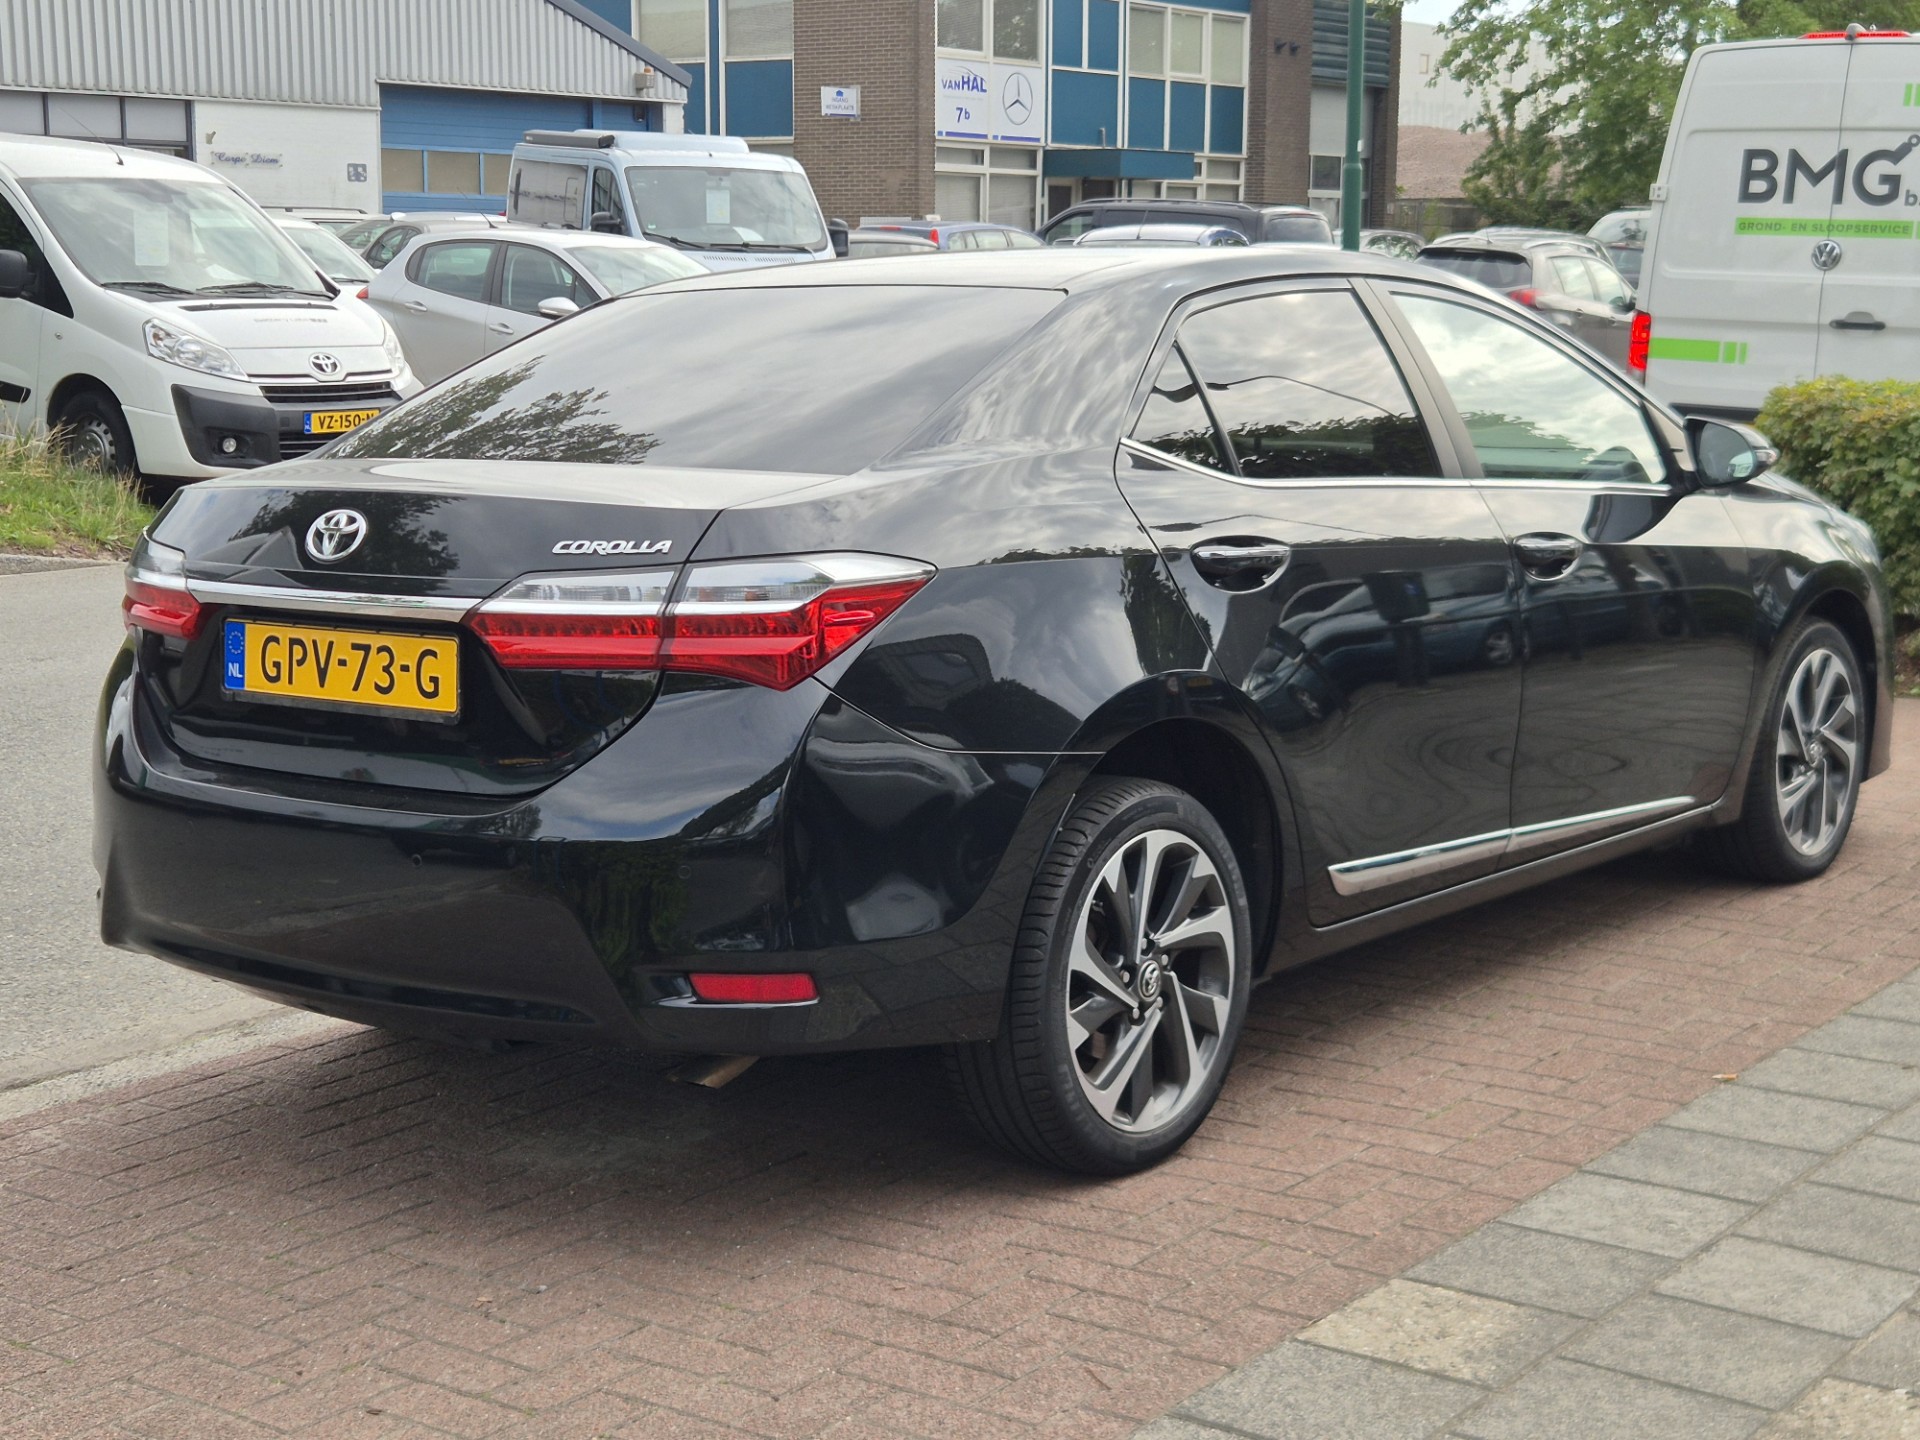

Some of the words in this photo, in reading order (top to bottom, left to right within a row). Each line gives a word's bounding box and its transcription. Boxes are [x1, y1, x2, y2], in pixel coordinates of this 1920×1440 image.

[1738, 147, 1902, 206] BMG
[1738, 222, 1786, 231] GROND-
[1790, 223, 1807, 232] EN
[1811, 223, 1910, 234] SLOOPSERVICE
[552, 540, 673, 555] COROLLA
[228, 662, 243, 678] NL
[260, 635, 440, 699] GPV-73-G
